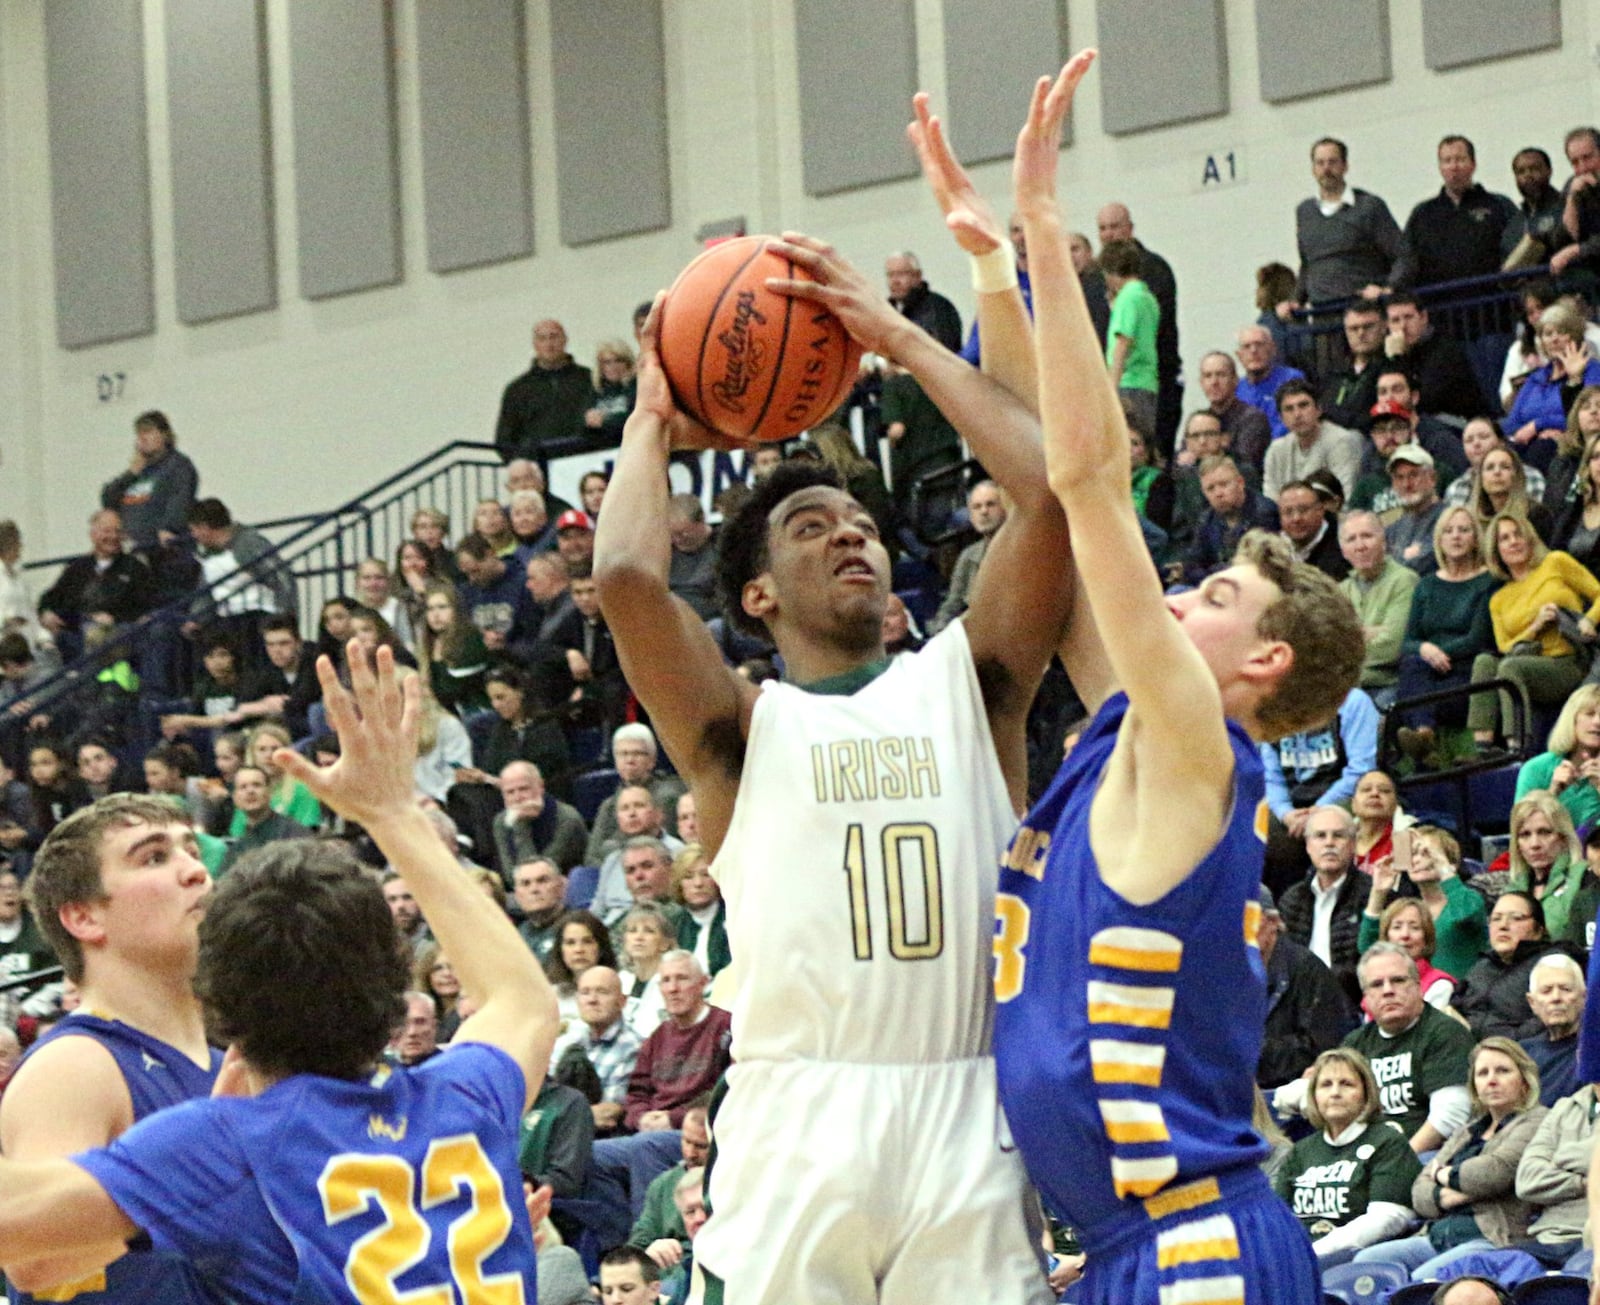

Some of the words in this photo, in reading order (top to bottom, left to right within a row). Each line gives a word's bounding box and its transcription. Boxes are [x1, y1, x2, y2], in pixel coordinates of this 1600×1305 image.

[1202, 152, 1235, 186] A1
[712, 290, 767, 415] Rawlings
[811, 736, 941, 803] IRISH
[843, 821, 944, 961] 10
[1371, 1051, 1412, 1088] REEN
[1294, 1160, 1358, 1188] GREEN
[316, 1132, 526, 1305] 22
[1293, 1186, 1351, 1217] SCARE
